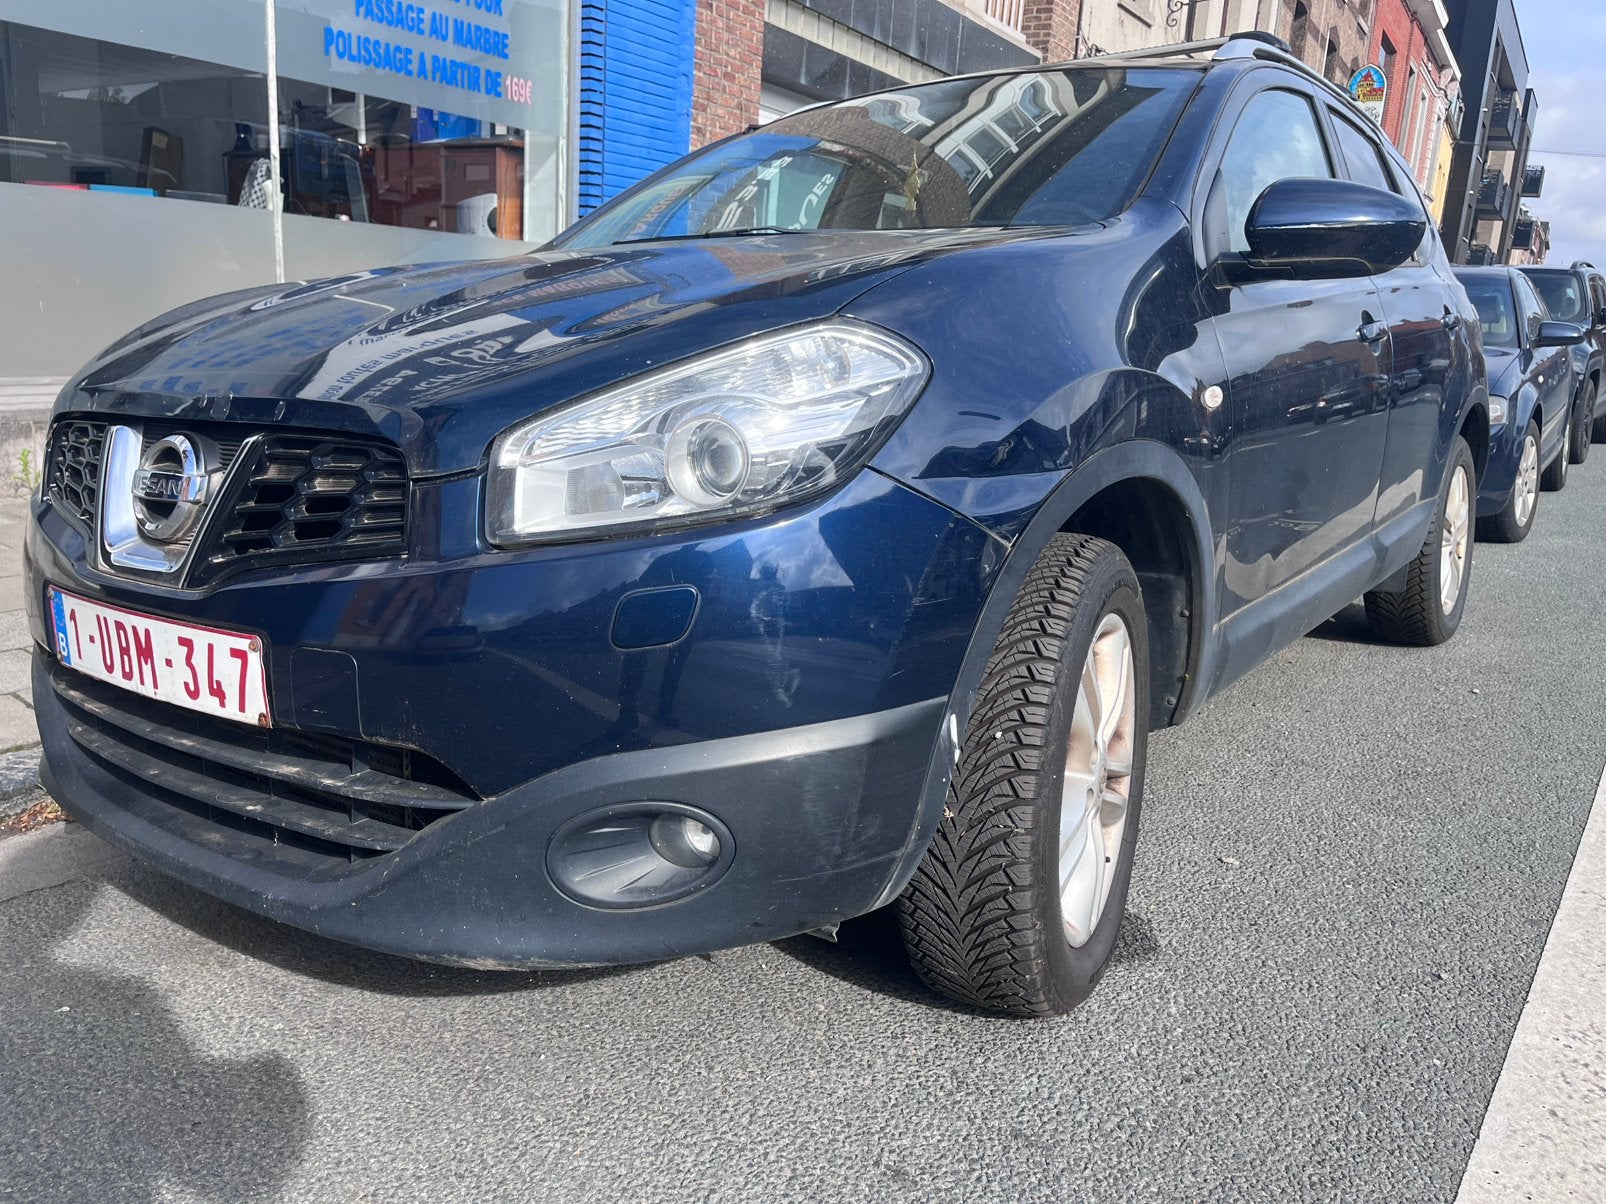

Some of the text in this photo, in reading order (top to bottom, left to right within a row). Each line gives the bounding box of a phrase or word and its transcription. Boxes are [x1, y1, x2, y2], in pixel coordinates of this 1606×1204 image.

[355, 0, 509, 60] PASSAGE AU MARBRE
[323, 26, 533, 104] POLISSAGE A PARTIR DE 169€
[58, 633, 69, 656] B
[69, 608, 249, 713] 1-UBM-347
